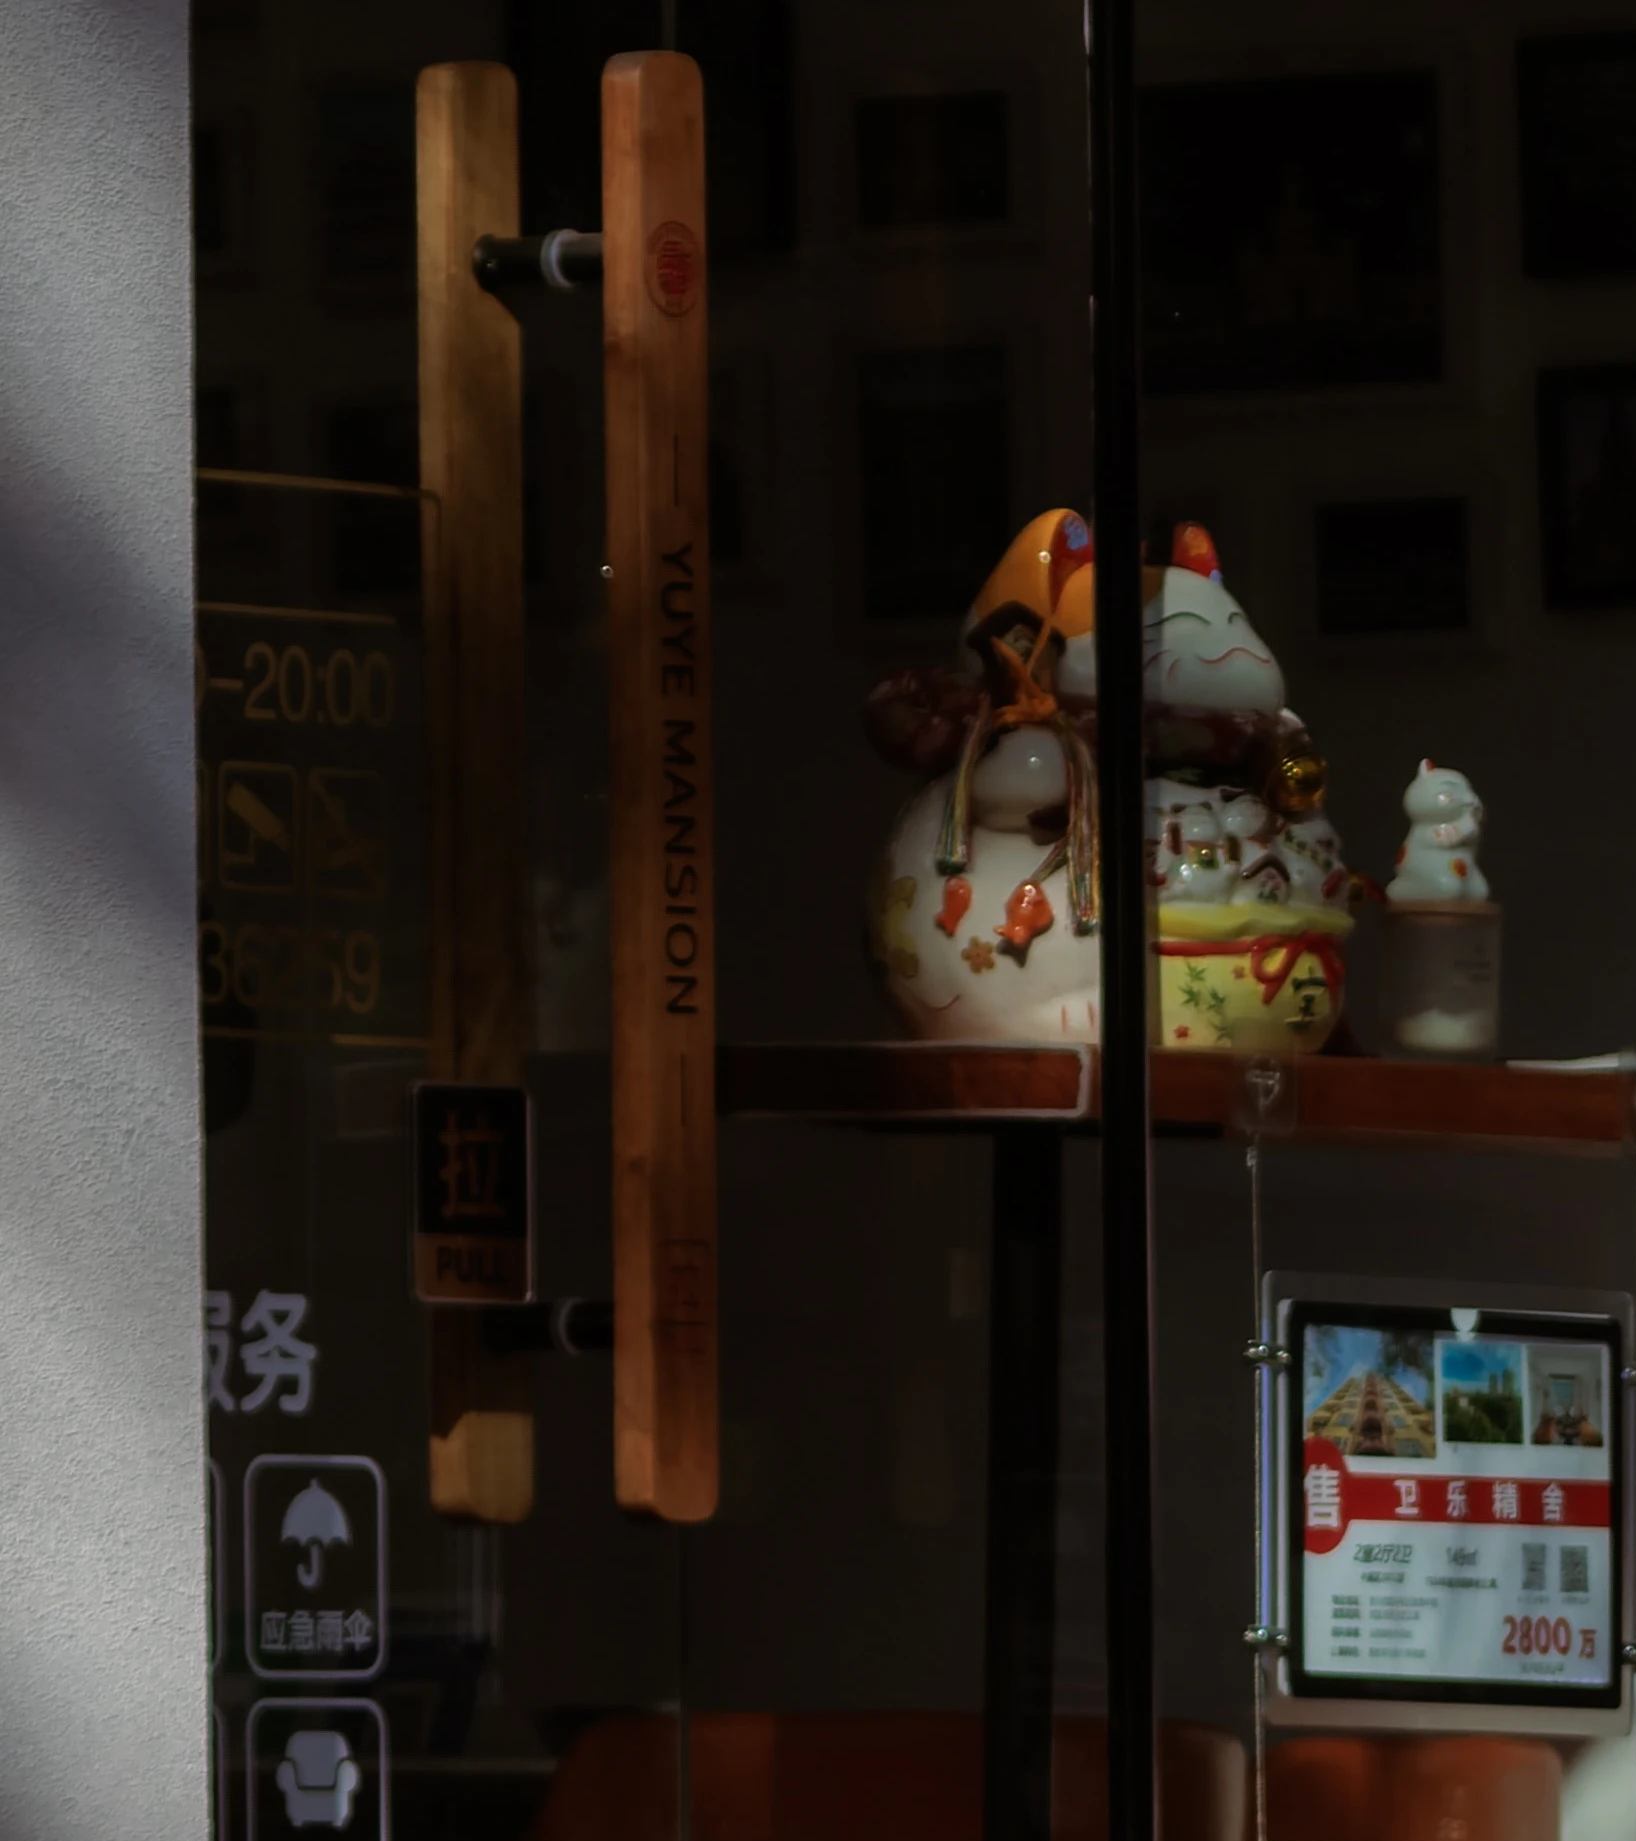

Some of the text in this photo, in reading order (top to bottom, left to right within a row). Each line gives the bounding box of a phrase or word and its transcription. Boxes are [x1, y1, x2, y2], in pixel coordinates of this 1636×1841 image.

[661, 541, 698, 1016] YUYE MANSION
[437, 1108, 507, 1220] 拉
[437, 1245, 508, 1284] PULL
[1304, 1463, 1565, 1529] 售 卫乐精舍
[260, 1609, 374, 1654] 应急雨伞
[1501, 1614, 1572, 1655] 2800
[1578, 1627, 1598, 1659] 万
